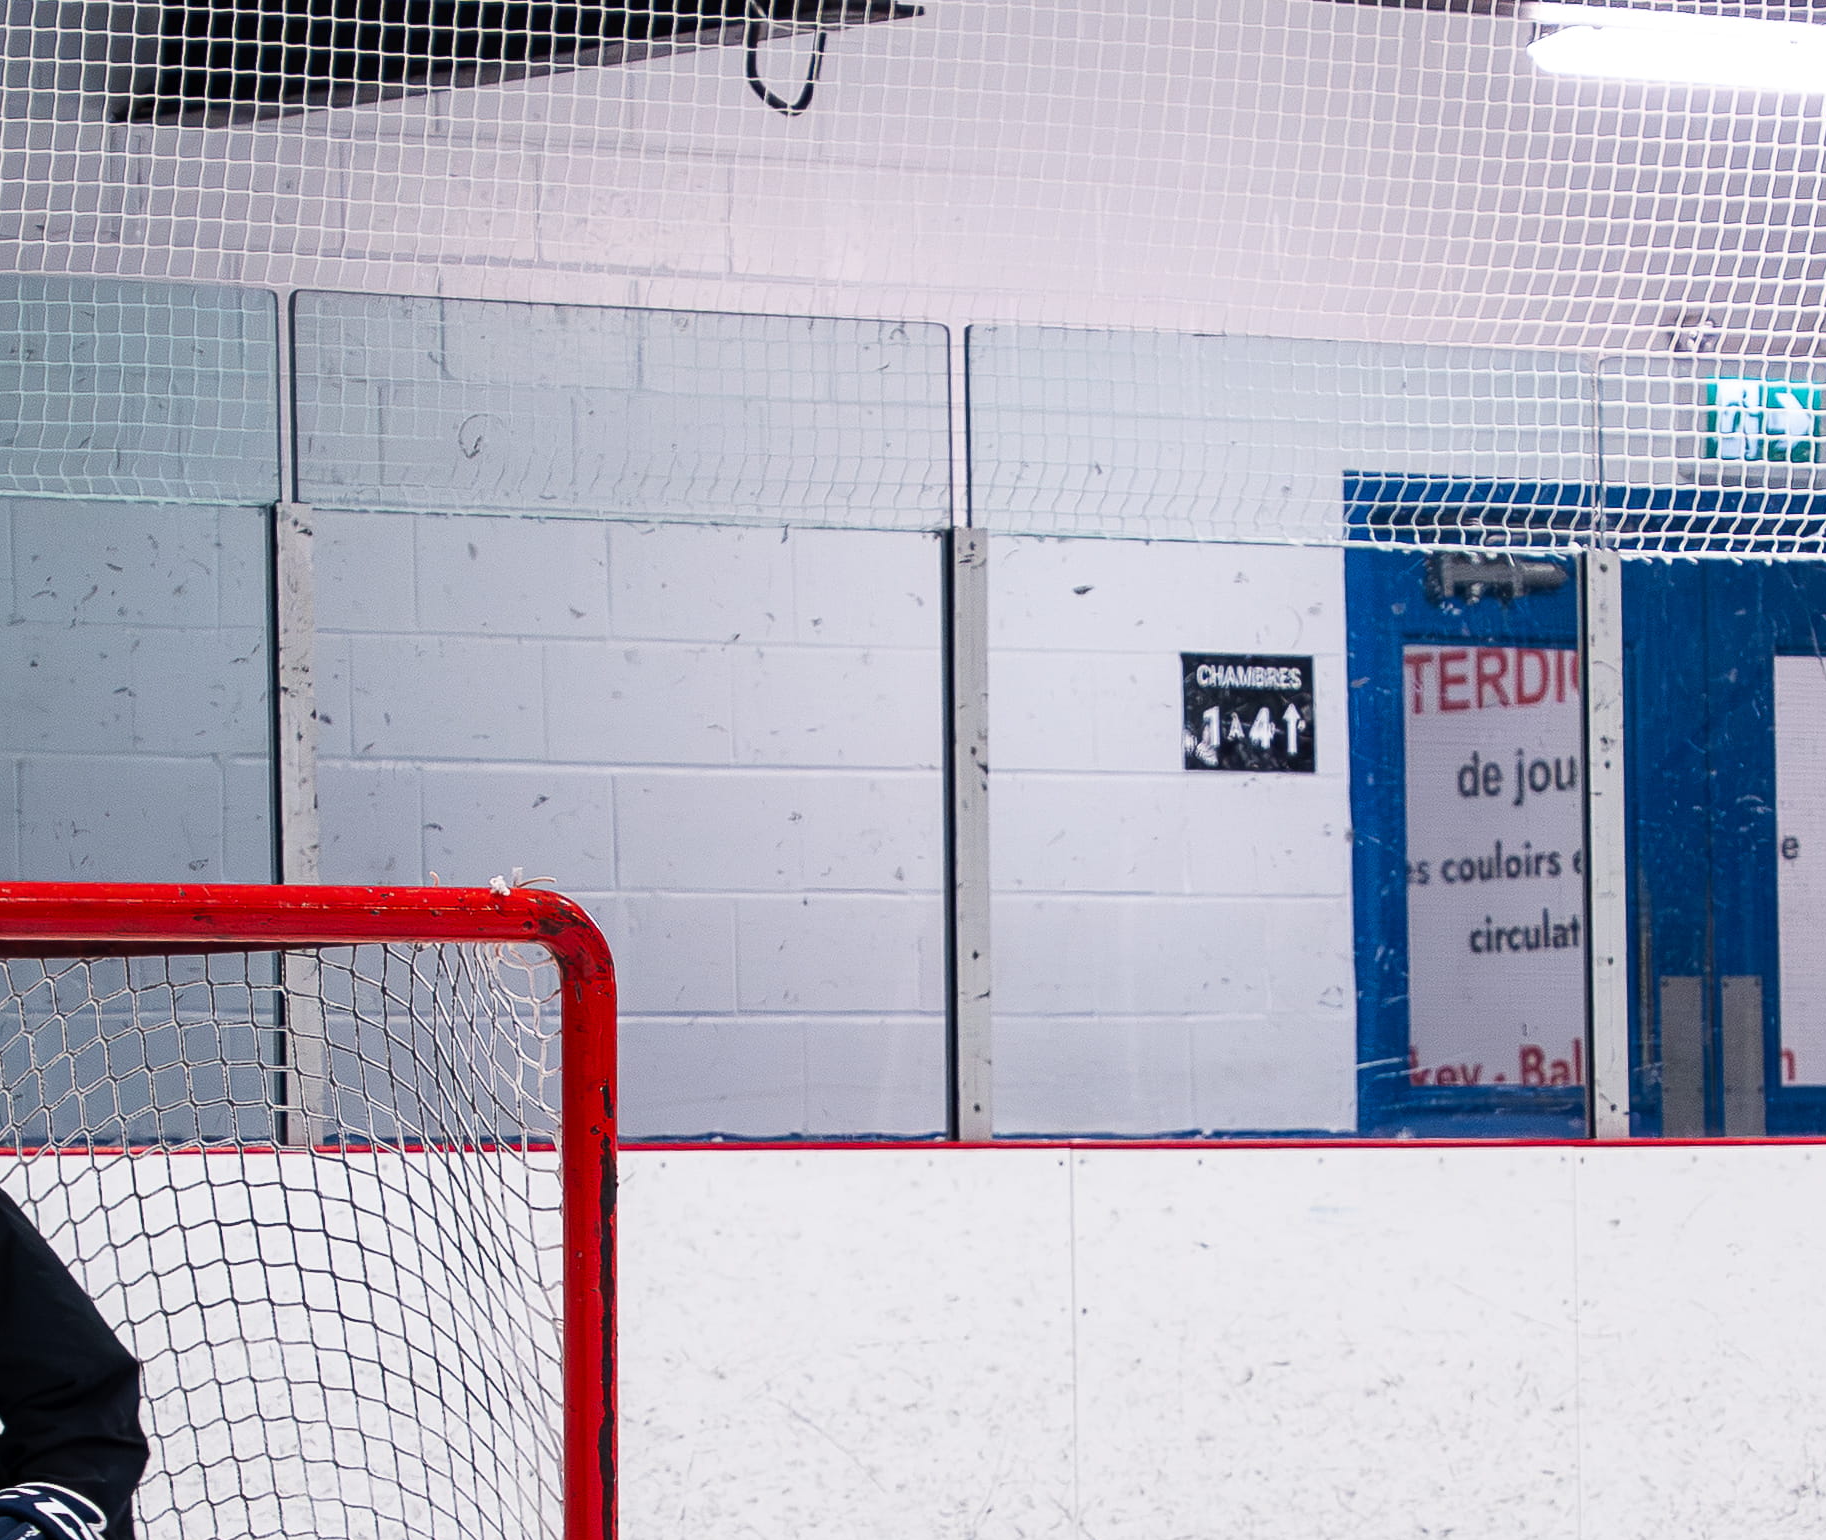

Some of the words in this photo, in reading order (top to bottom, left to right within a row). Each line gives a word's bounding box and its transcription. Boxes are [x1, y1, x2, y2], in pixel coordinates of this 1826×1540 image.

[1196, 664, 1302, 689] CHAMBRES
[1249, 706, 1275, 749] 4
[1457, 750, 1503, 797] de
[1441, 839, 1561, 884] couloirs
[1469, 907, 1581, 953] circulat
